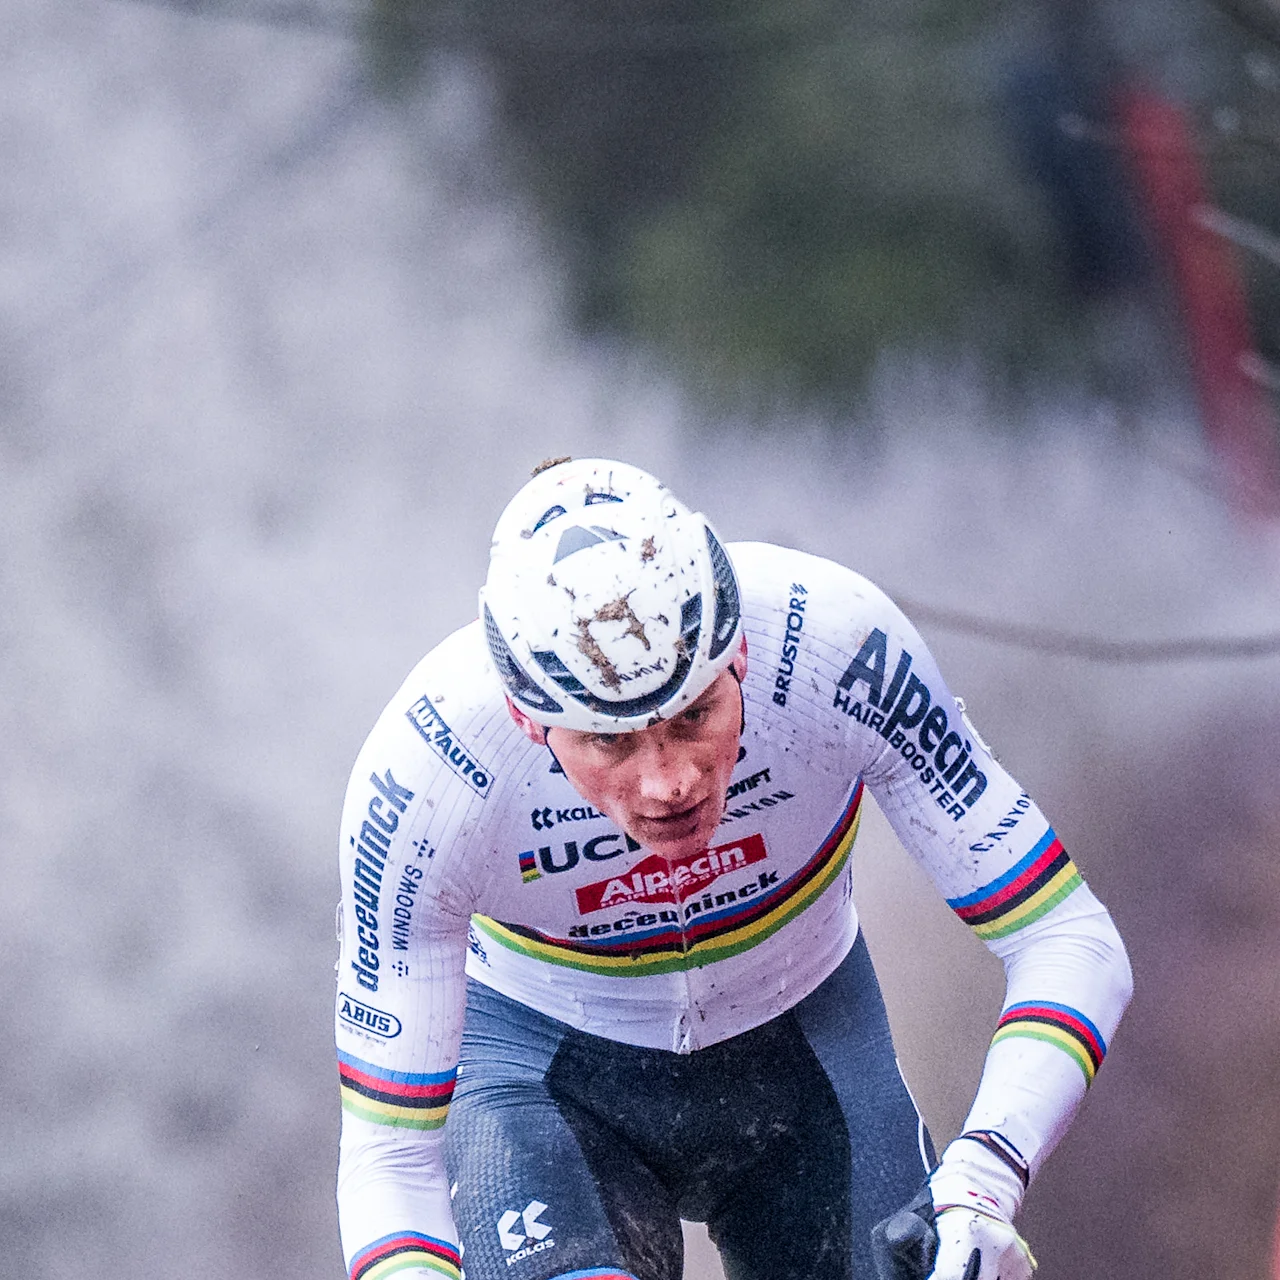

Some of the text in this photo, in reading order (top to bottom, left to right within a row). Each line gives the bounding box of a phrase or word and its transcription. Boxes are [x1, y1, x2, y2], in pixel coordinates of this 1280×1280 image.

[773, 597, 807, 707] BRUSTOR
[833, 689, 966, 822] HAIR BOOSTER
[837, 627, 988, 809] Alpecin
[969, 793, 1032, 853] CANYO
[350, 768, 415, 993] deceuninck
[393, 865, 423, 950] WINDOWS
[568, 870, 780, 938] deceuninck
[600, 845, 747, 904] Alpecin
[341, 1000, 391, 1033] ABUS
